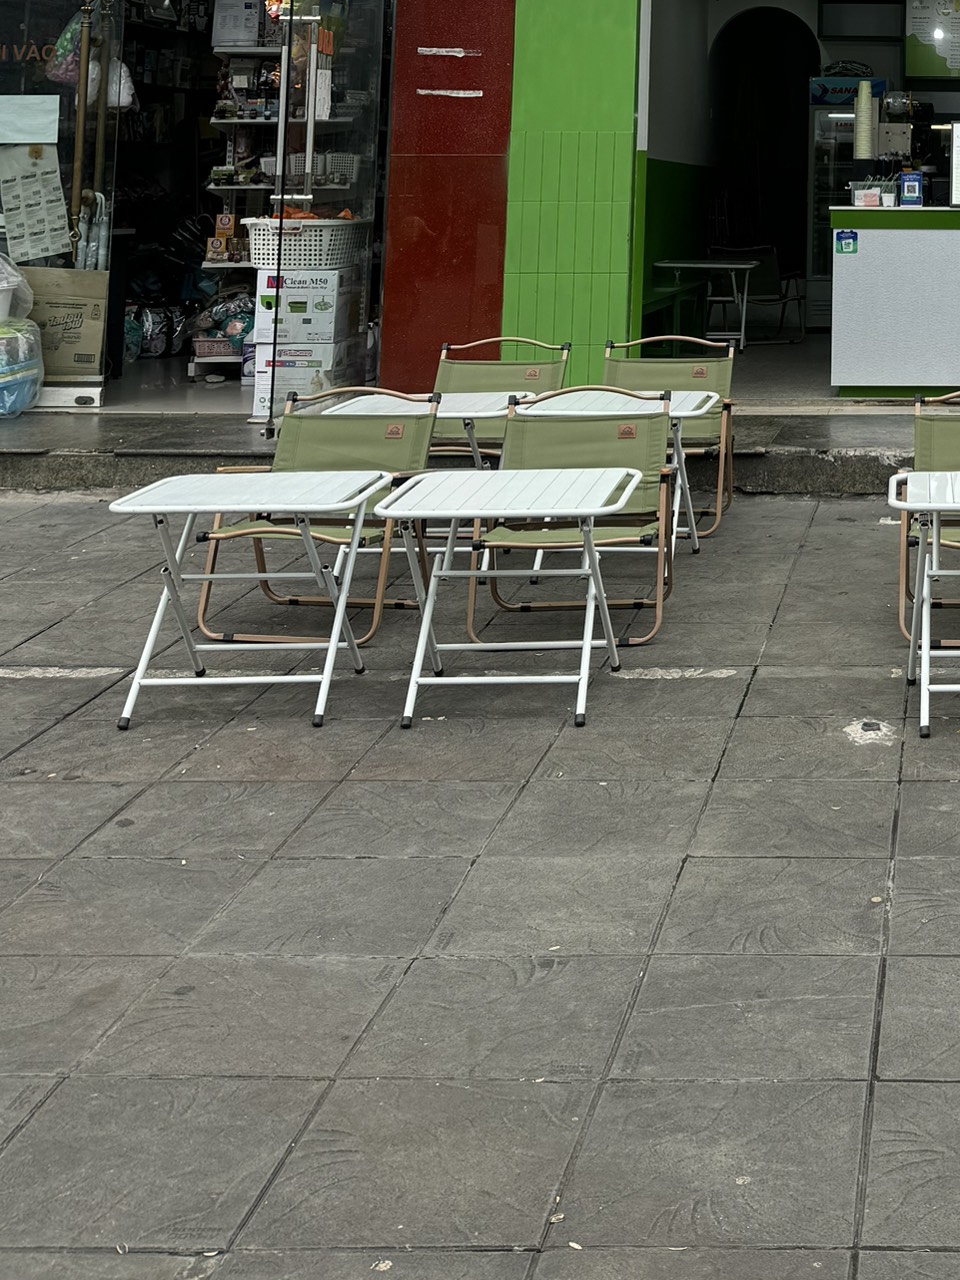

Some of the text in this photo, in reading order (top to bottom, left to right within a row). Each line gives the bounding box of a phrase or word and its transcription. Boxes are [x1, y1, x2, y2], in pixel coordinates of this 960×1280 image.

[12, 39, 55, 61] VÀO
[284, 278, 307, 286] Clean
[310, 278, 328, 286] M50
